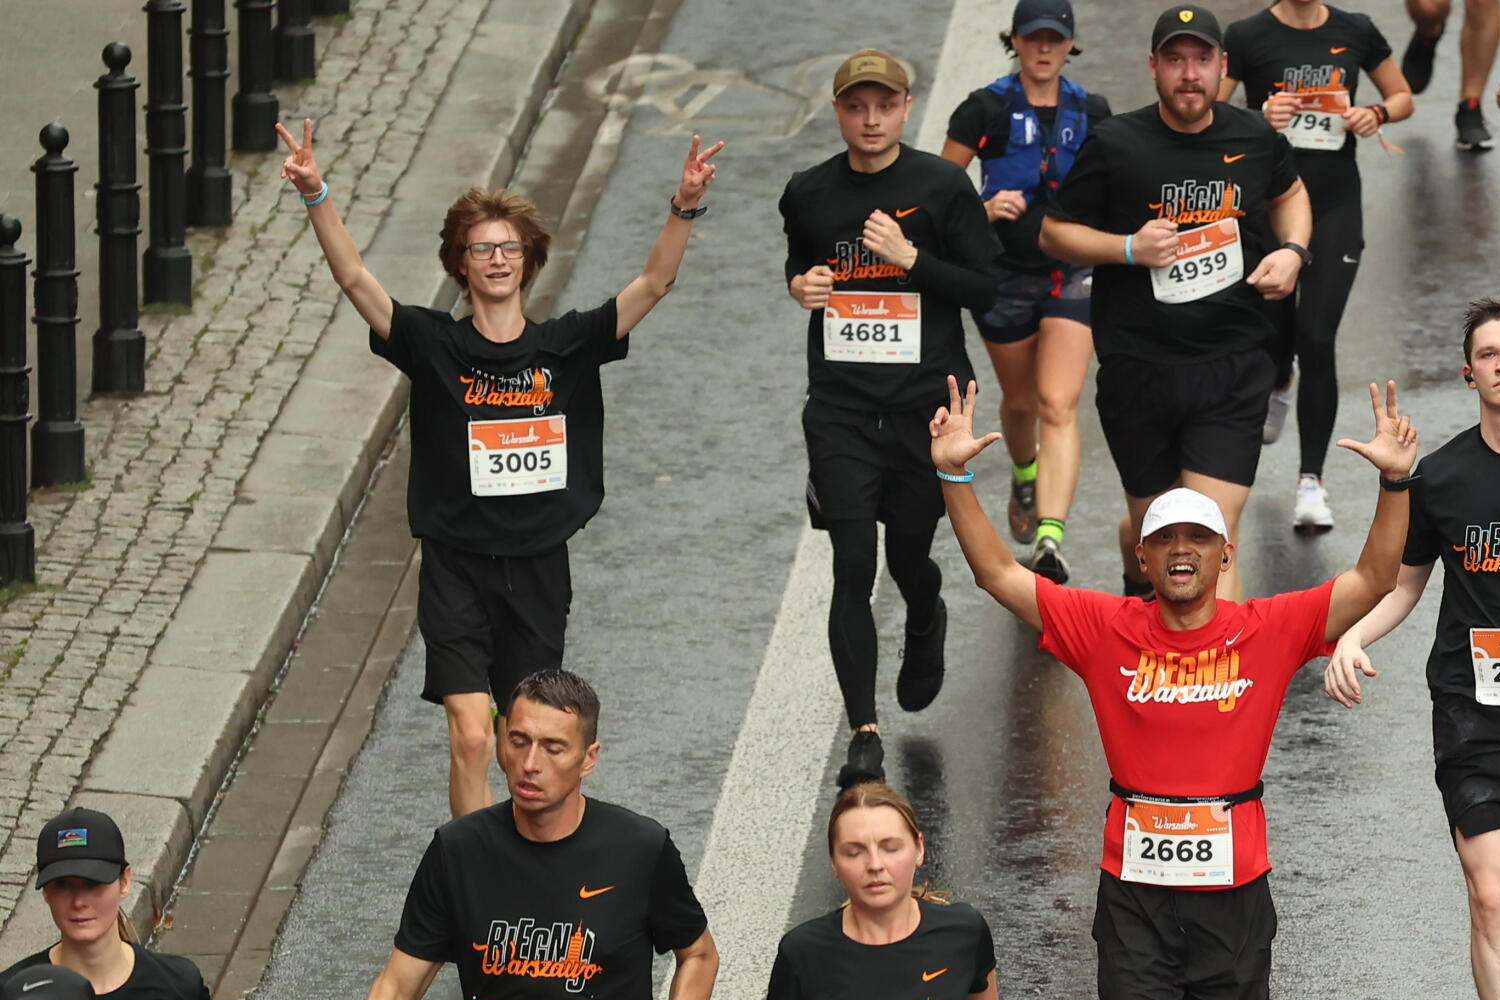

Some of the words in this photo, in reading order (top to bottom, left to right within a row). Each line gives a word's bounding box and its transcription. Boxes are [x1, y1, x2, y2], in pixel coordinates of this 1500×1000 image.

[1291, 113, 1331, 132] 794
[1168, 252, 1228, 283] 4939
[840, 323, 902, 342] 4681
[488, 450, 552, 474] 3005
[1120, 666, 1253, 704] Warszawo
[1140, 837, 1213, 863] 2668
[473, 941, 603, 980] Warszawo
